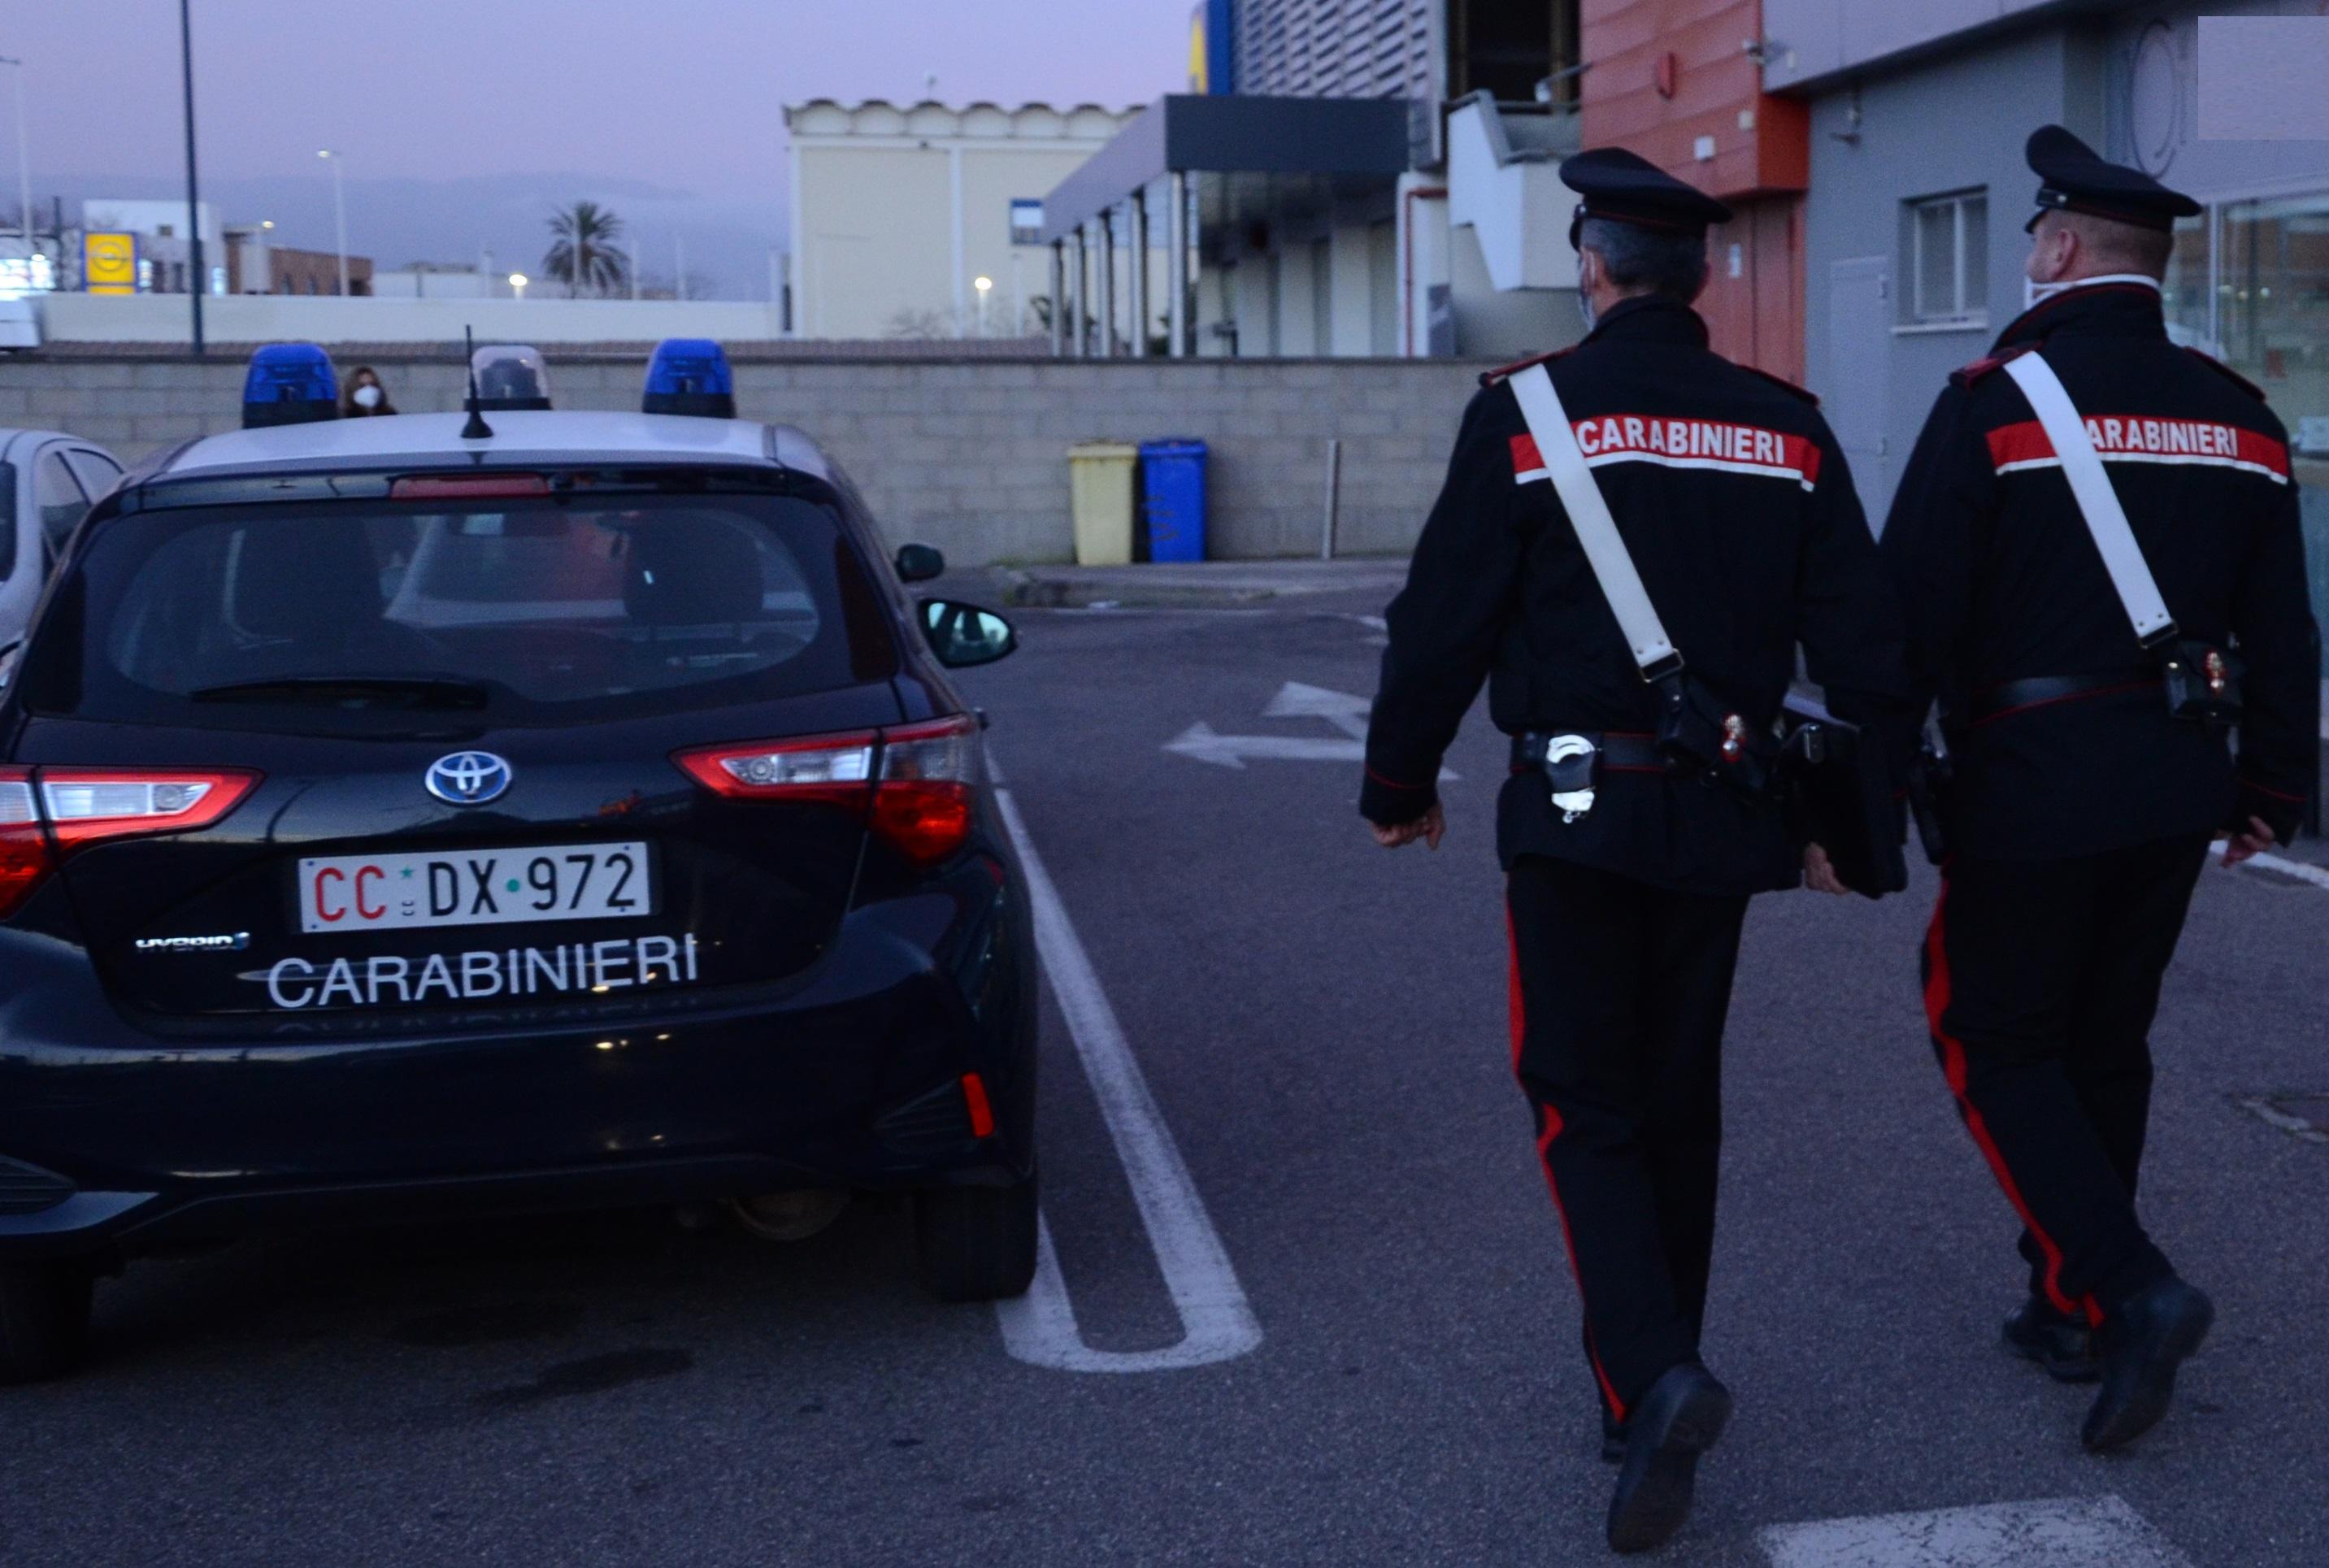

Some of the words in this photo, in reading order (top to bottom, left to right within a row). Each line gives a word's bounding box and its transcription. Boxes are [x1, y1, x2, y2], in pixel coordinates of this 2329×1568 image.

[1575, 417, 1785, 464] CARABINIERI
[2084, 419, 2238, 457] ARABINIERI
[314, 865, 388, 923] CC
[428, 859, 499, 917] DX
[527, 853, 636, 910] 972
[267, 932, 697, 1008] CARABINIERI
